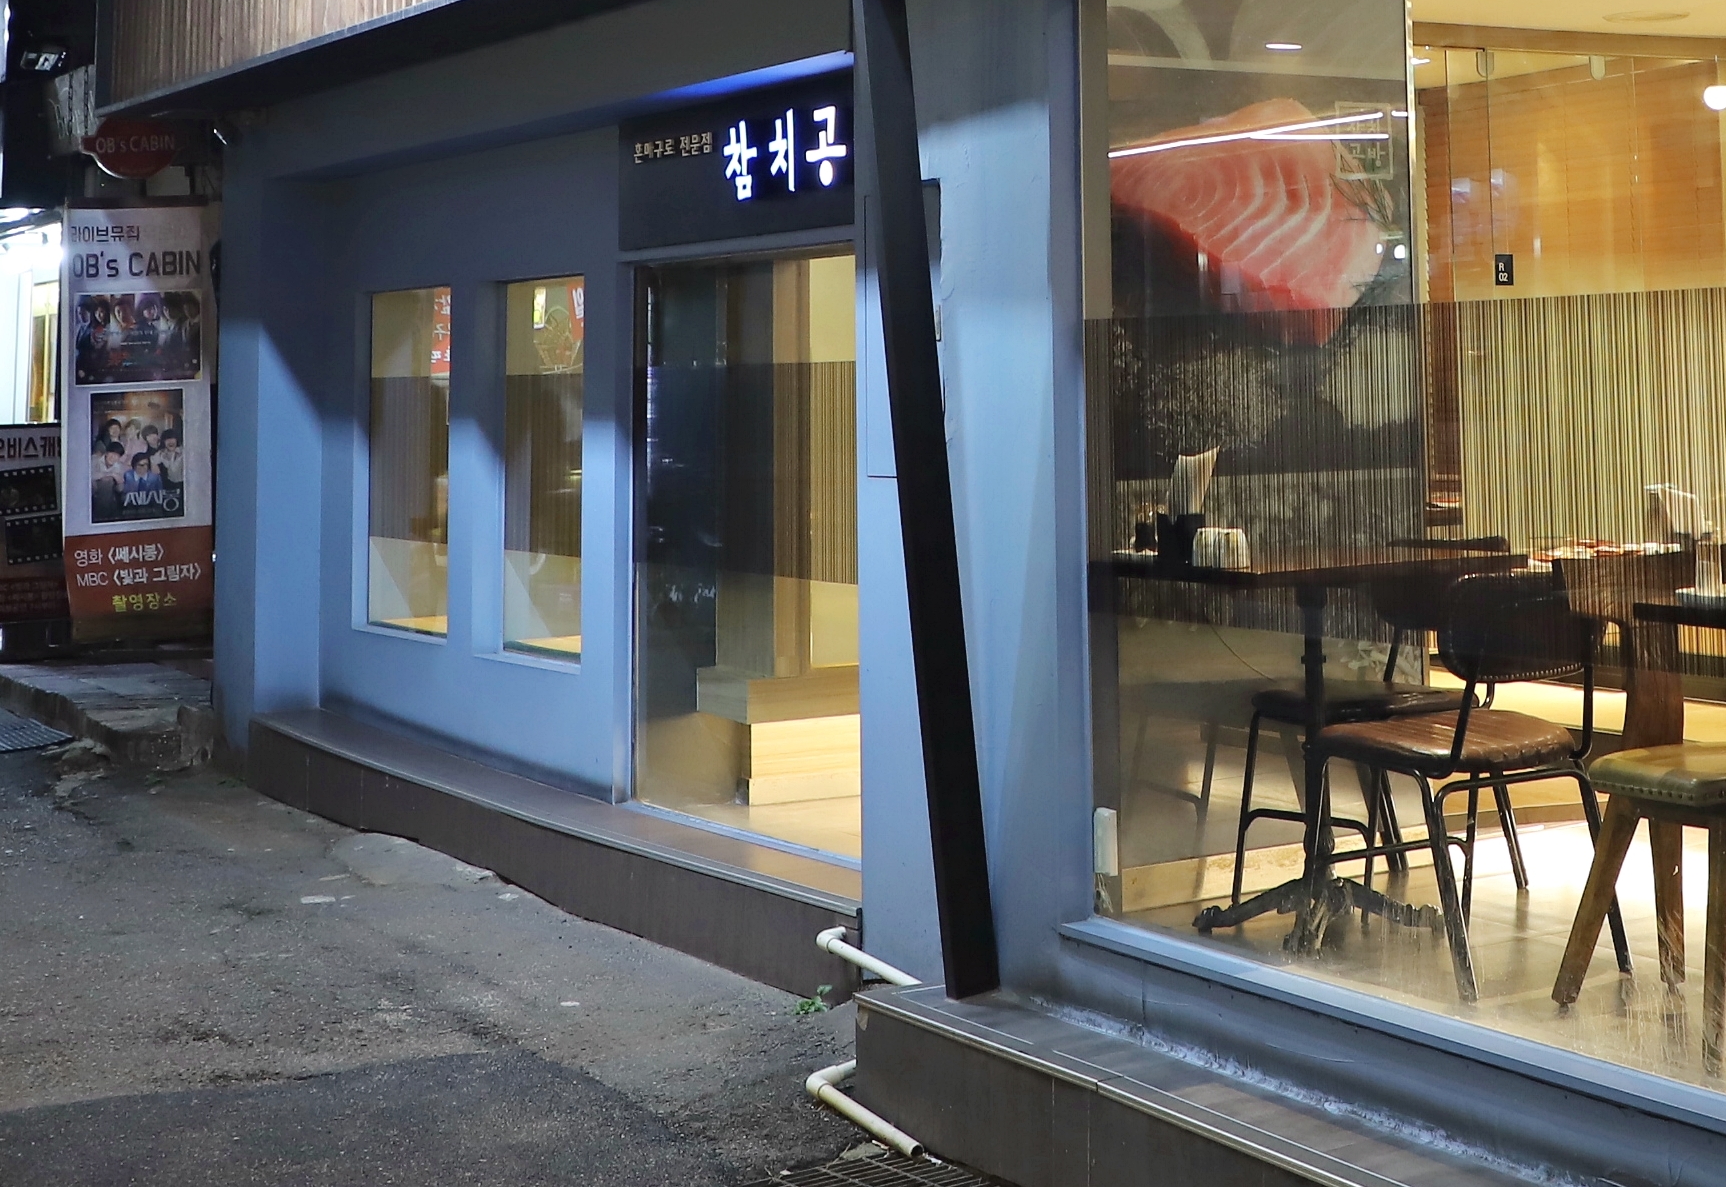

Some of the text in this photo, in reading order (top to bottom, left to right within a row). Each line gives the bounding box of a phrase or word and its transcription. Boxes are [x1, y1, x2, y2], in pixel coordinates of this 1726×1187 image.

[95, 135, 175, 154] OB's CABIN
[634, 106, 847, 201] 혼마구로 전문점 참치공
[71, 225, 140, 243] 라이브뮤직
[73, 250, 200, 278] OB's CABIN
[1499, 262, 1505, 272] R
[1498, 272, 1509, 282] 02
[0, 437, 60, 459] 비스캐
[74, 548, 103, 567] 영화
[76, 571, 109, 587] MBC
[112, 592, 177, 612] 촬영장소
